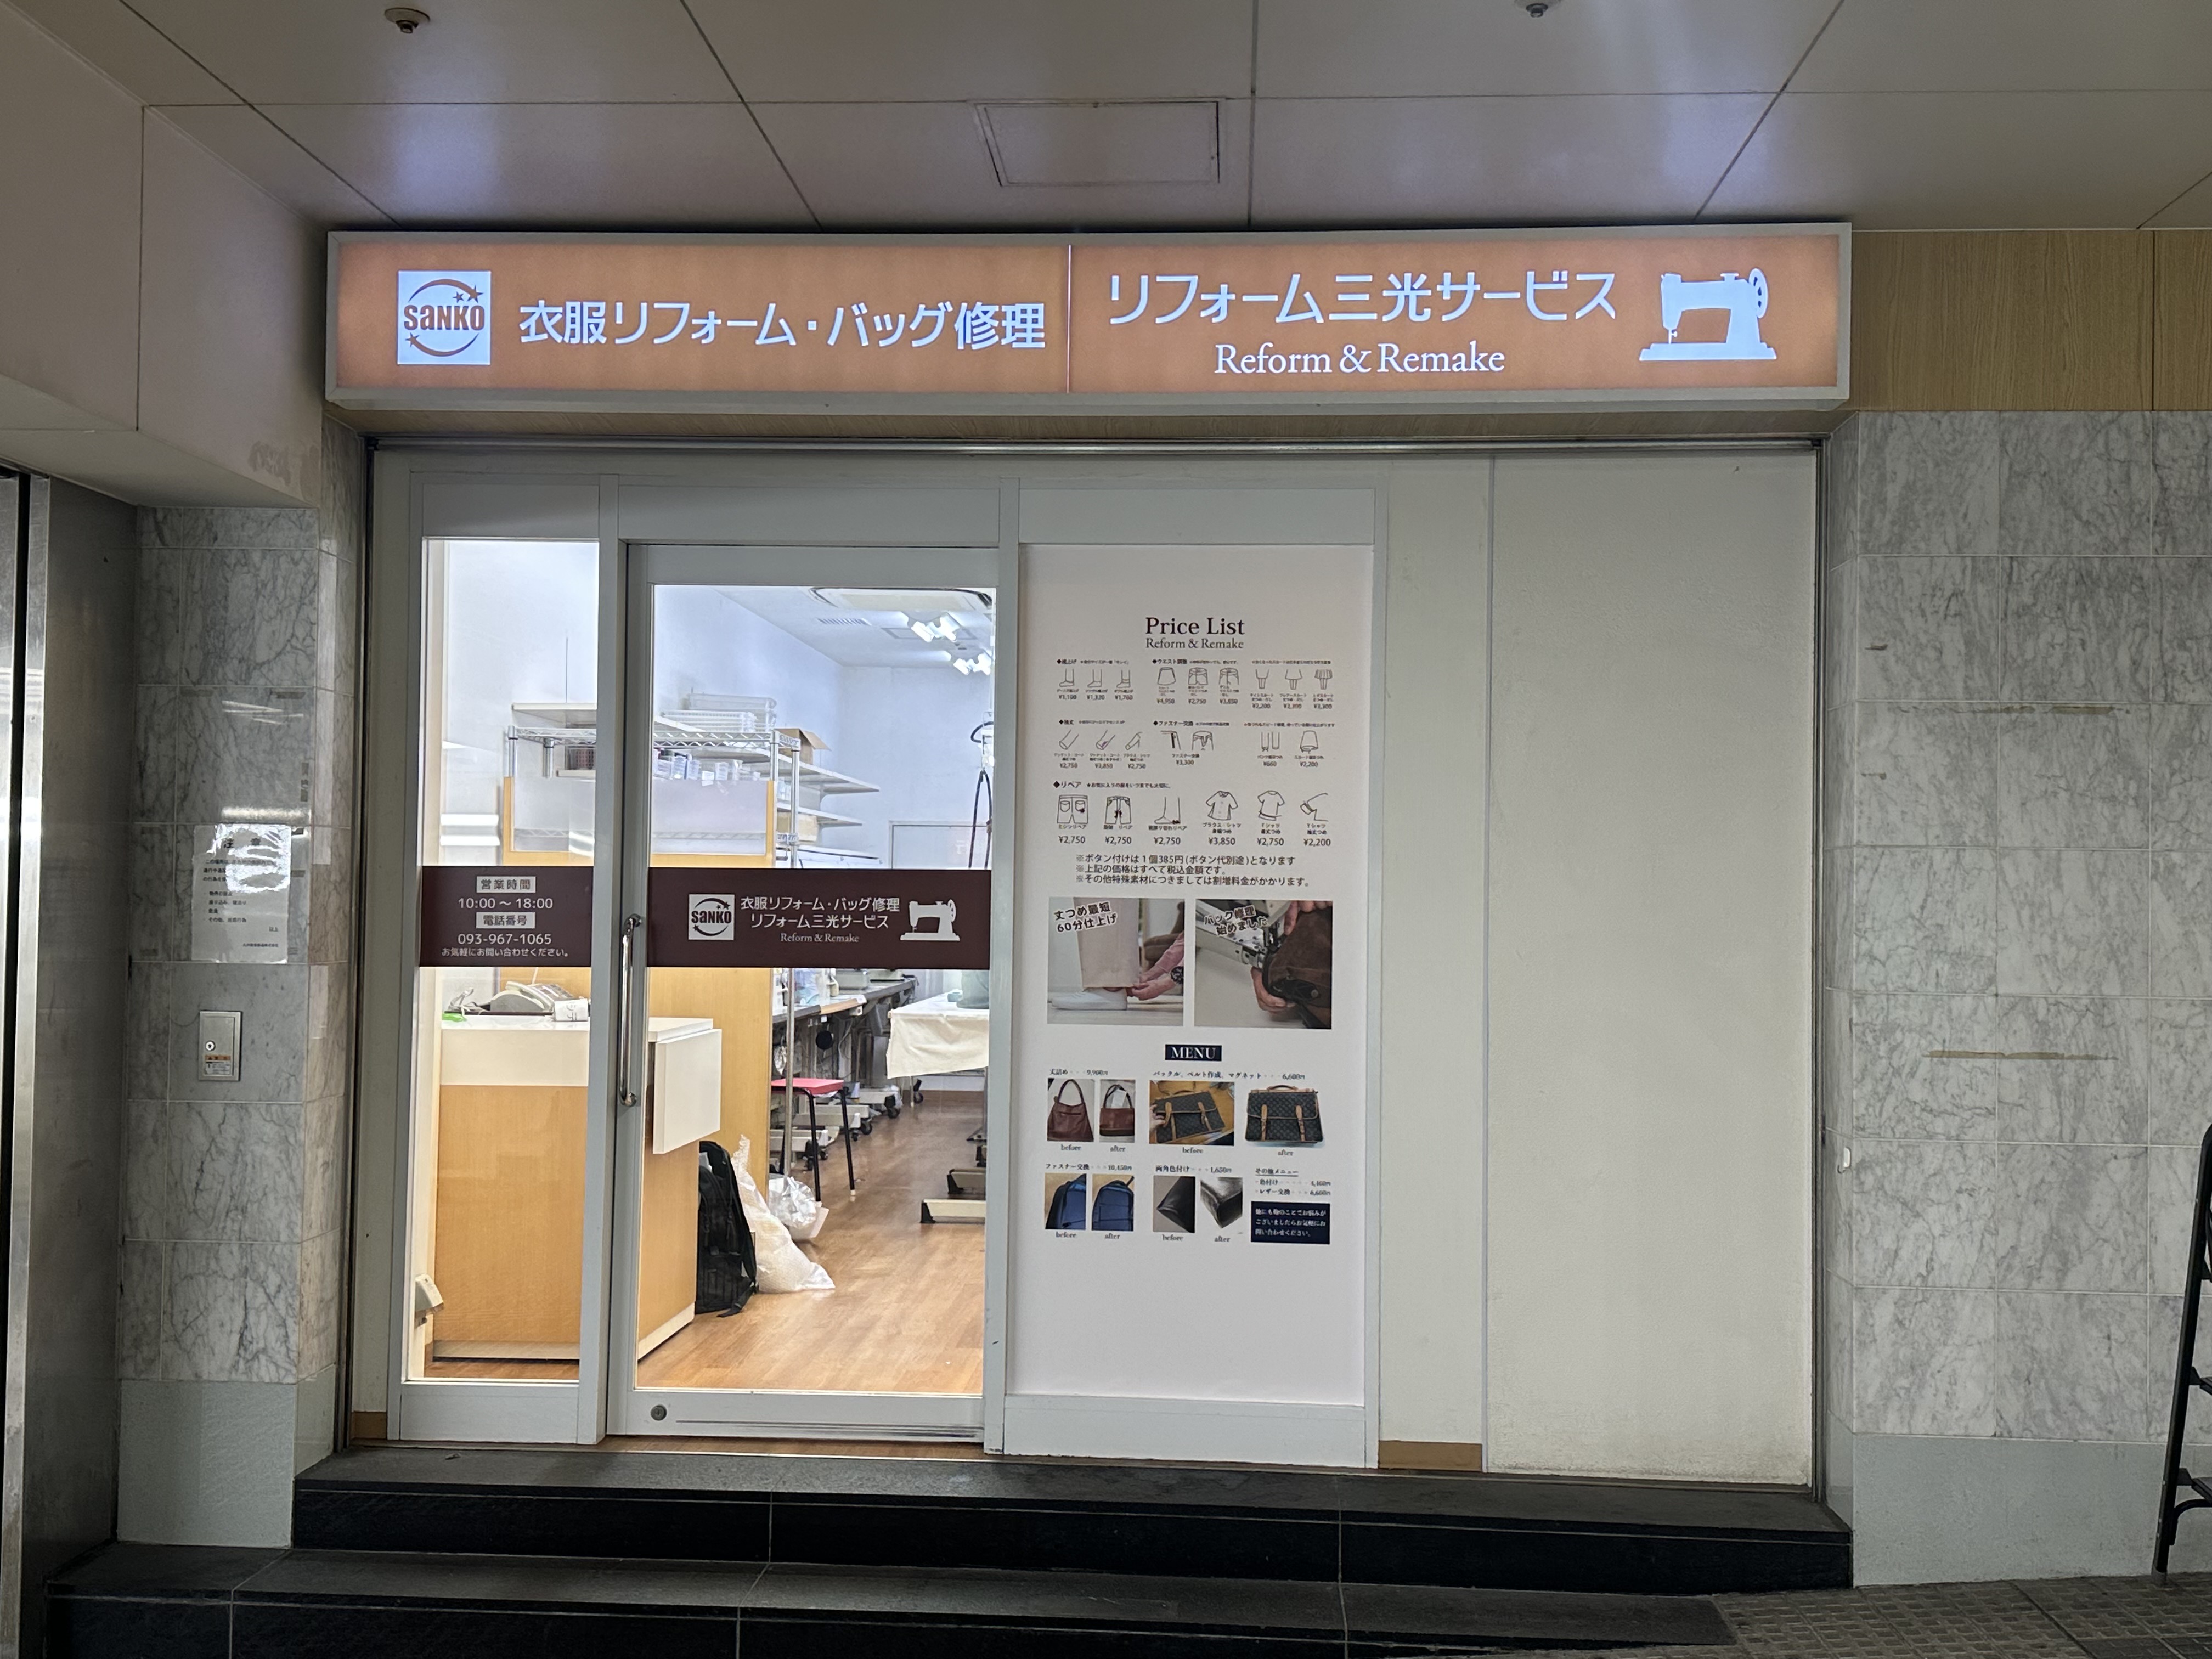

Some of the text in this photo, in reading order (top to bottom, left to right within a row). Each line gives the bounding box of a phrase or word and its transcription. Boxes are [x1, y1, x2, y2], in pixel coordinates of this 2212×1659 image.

[1109, 269, 1616, 325] リフォーム三光サービス
[518, 299, 1046, 351] 衣服リフォーム・バッグ修理
[1215, 340, 1505, 374] Reform & Remake
[1146, 617, 1245, 635] Price List
[1146, 637, 1244, 648] Reform & Remake
[1058, 836, 1086, 844] ¥2,750
[1105, 836, 1132, 845] ¥2,750
[1154, 837, 1181, 845] ¥2,750
[1208, 837, 1235, 846] ¥3,850
[1256, 837, 1284, 847] ¥2,750
[1304, 838, 1331, 847] ¥2,200
[481, 879, 531, 890] 営業時間
[458, 898, 496, 909] 10:00
[515, 898, 553, 909] 18:00
[740, 896, 900, 913] 衣服リフォーム・バッグ修理
[483, 915, 527, 926] 電話番号
[751, 915, 889, 929] リフォーム三光サービス
[1057, 913, 1118, 932] 60分仕上げ
[458, 933, 552, 945] 093-967-1065
[780, 933, 859, 943] Reform & Remake
[442, 947, 569, 957] お気軽にお問い合わせください。
[1171, 1047, 1216, 1059] MENU
